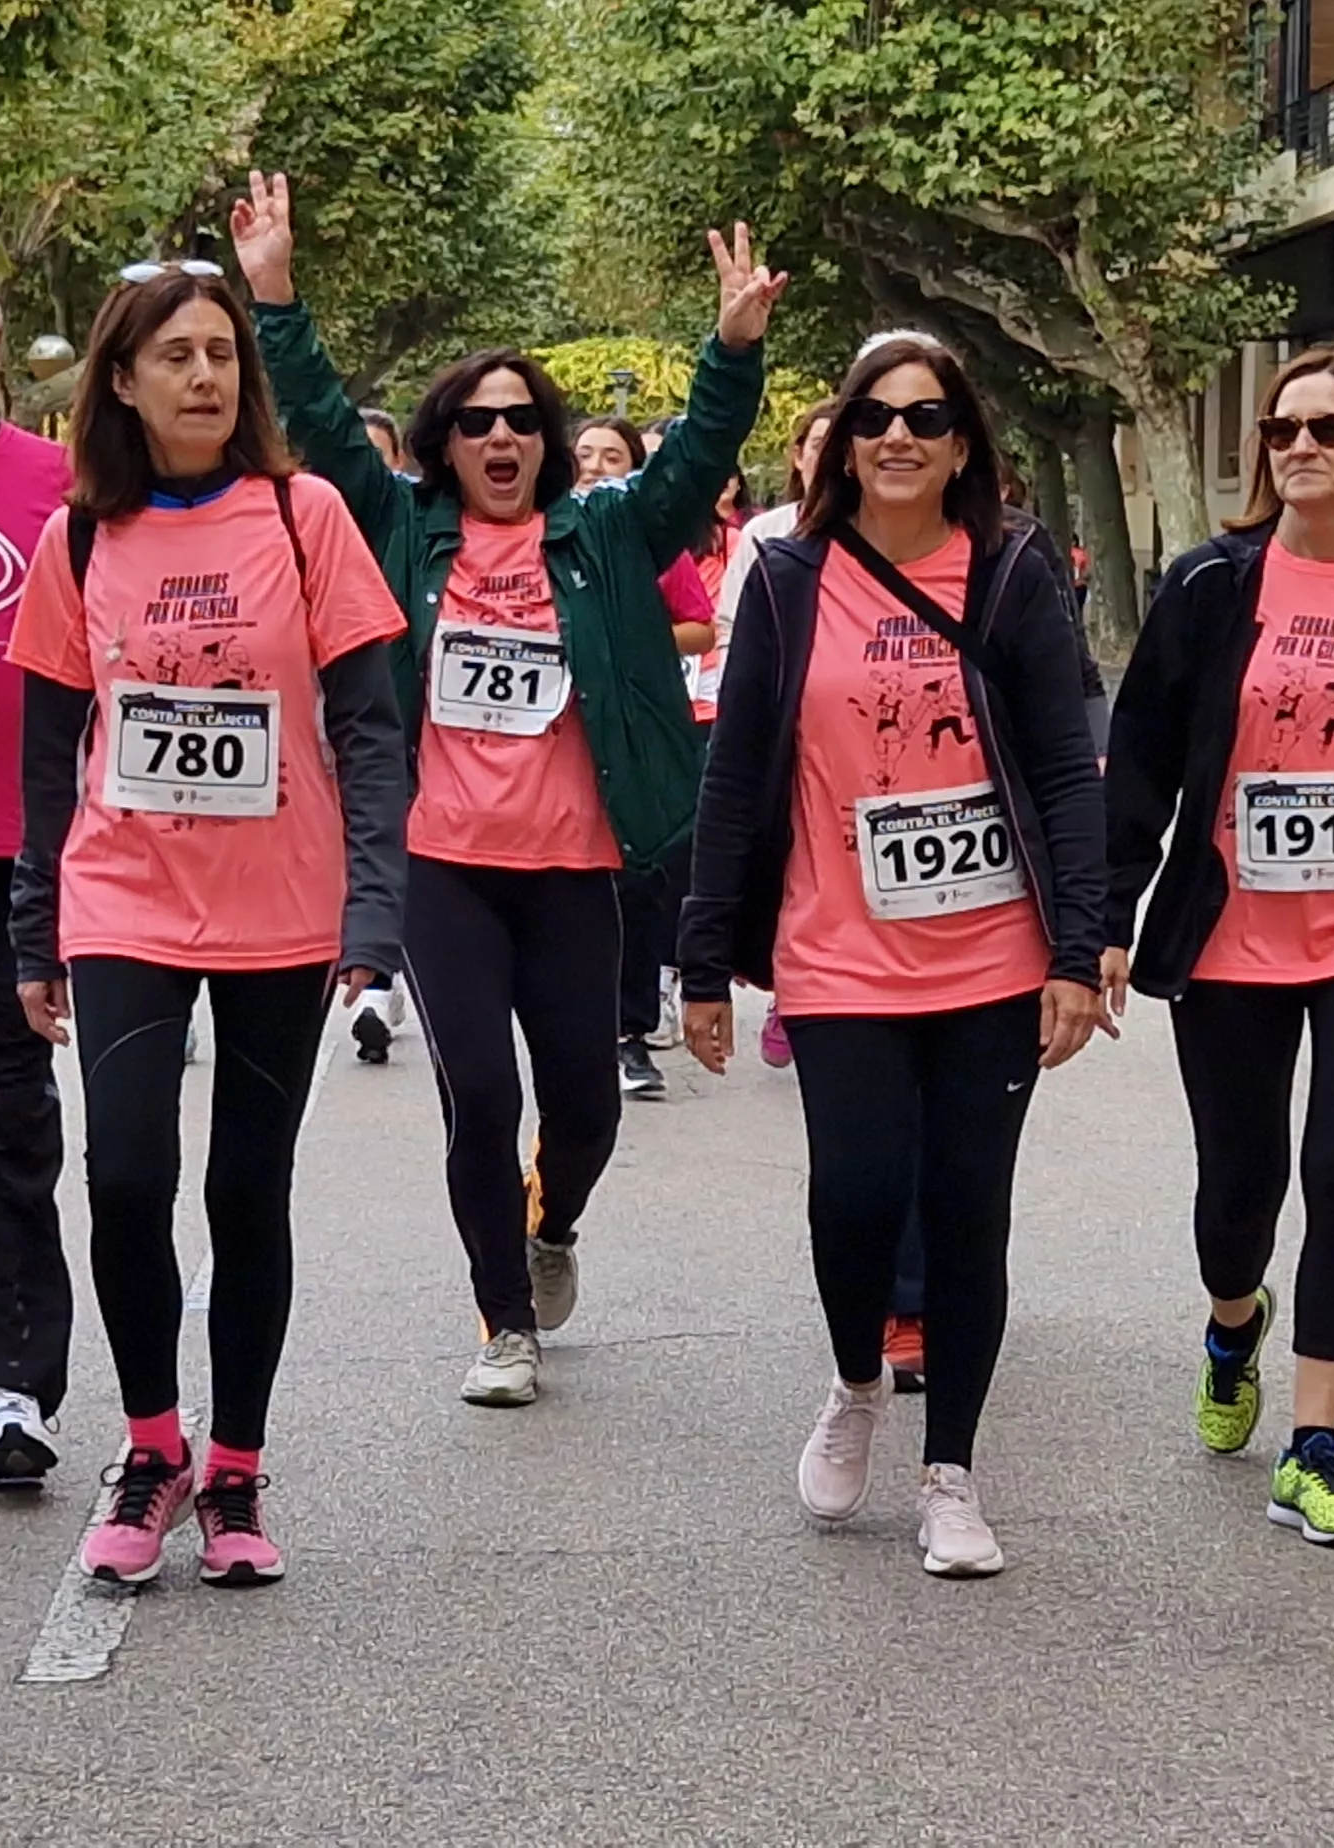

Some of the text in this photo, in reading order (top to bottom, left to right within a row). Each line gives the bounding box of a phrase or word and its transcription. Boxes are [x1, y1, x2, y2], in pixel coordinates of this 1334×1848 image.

[460, 660, 541, 705] 781
[128, 706, 185, 726] CONTRA
[187, 714, 204, 726] EL
[142, 728, 245, 780] 780
[876, 815, 936, 835] CONTRA
[880, 822, 1010, 884] 1920
